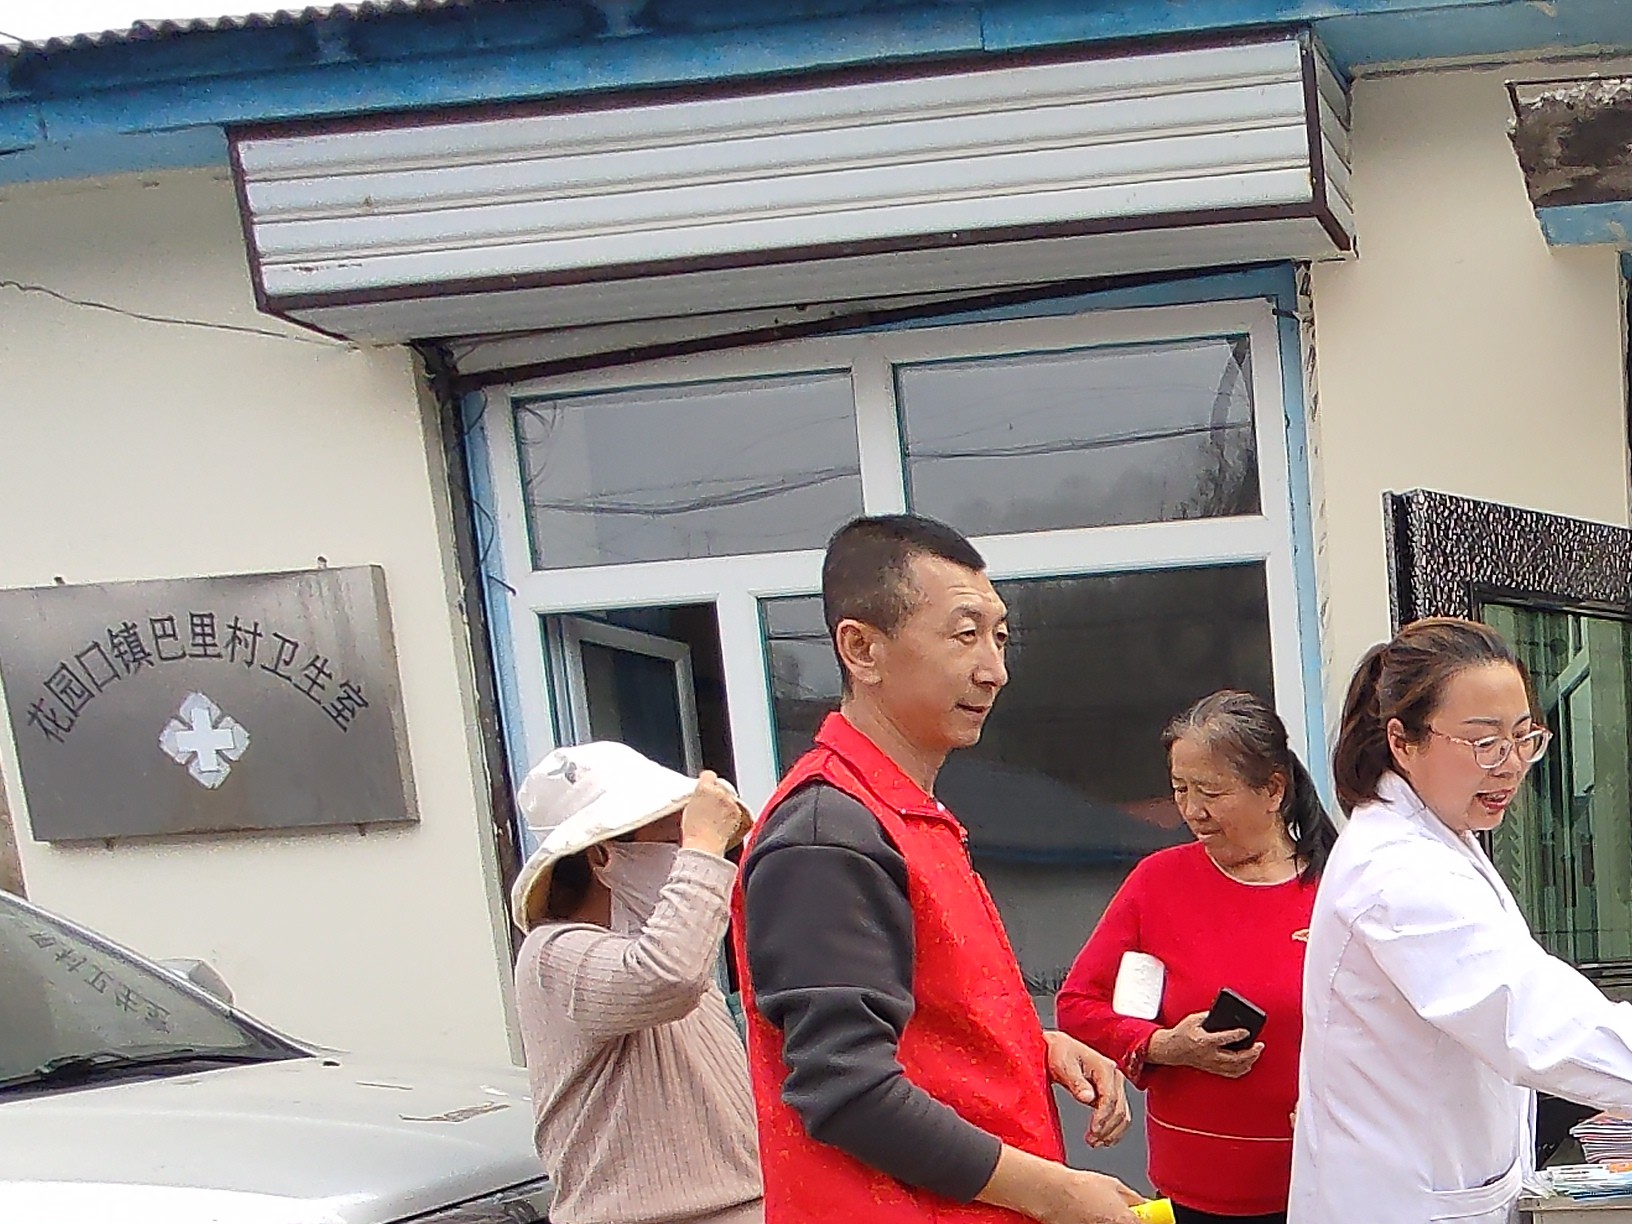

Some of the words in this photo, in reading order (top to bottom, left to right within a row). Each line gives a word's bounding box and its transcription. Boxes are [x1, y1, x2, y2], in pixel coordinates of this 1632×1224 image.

[27, 611, 370, 743] 花园口镇巴里村卫生室
